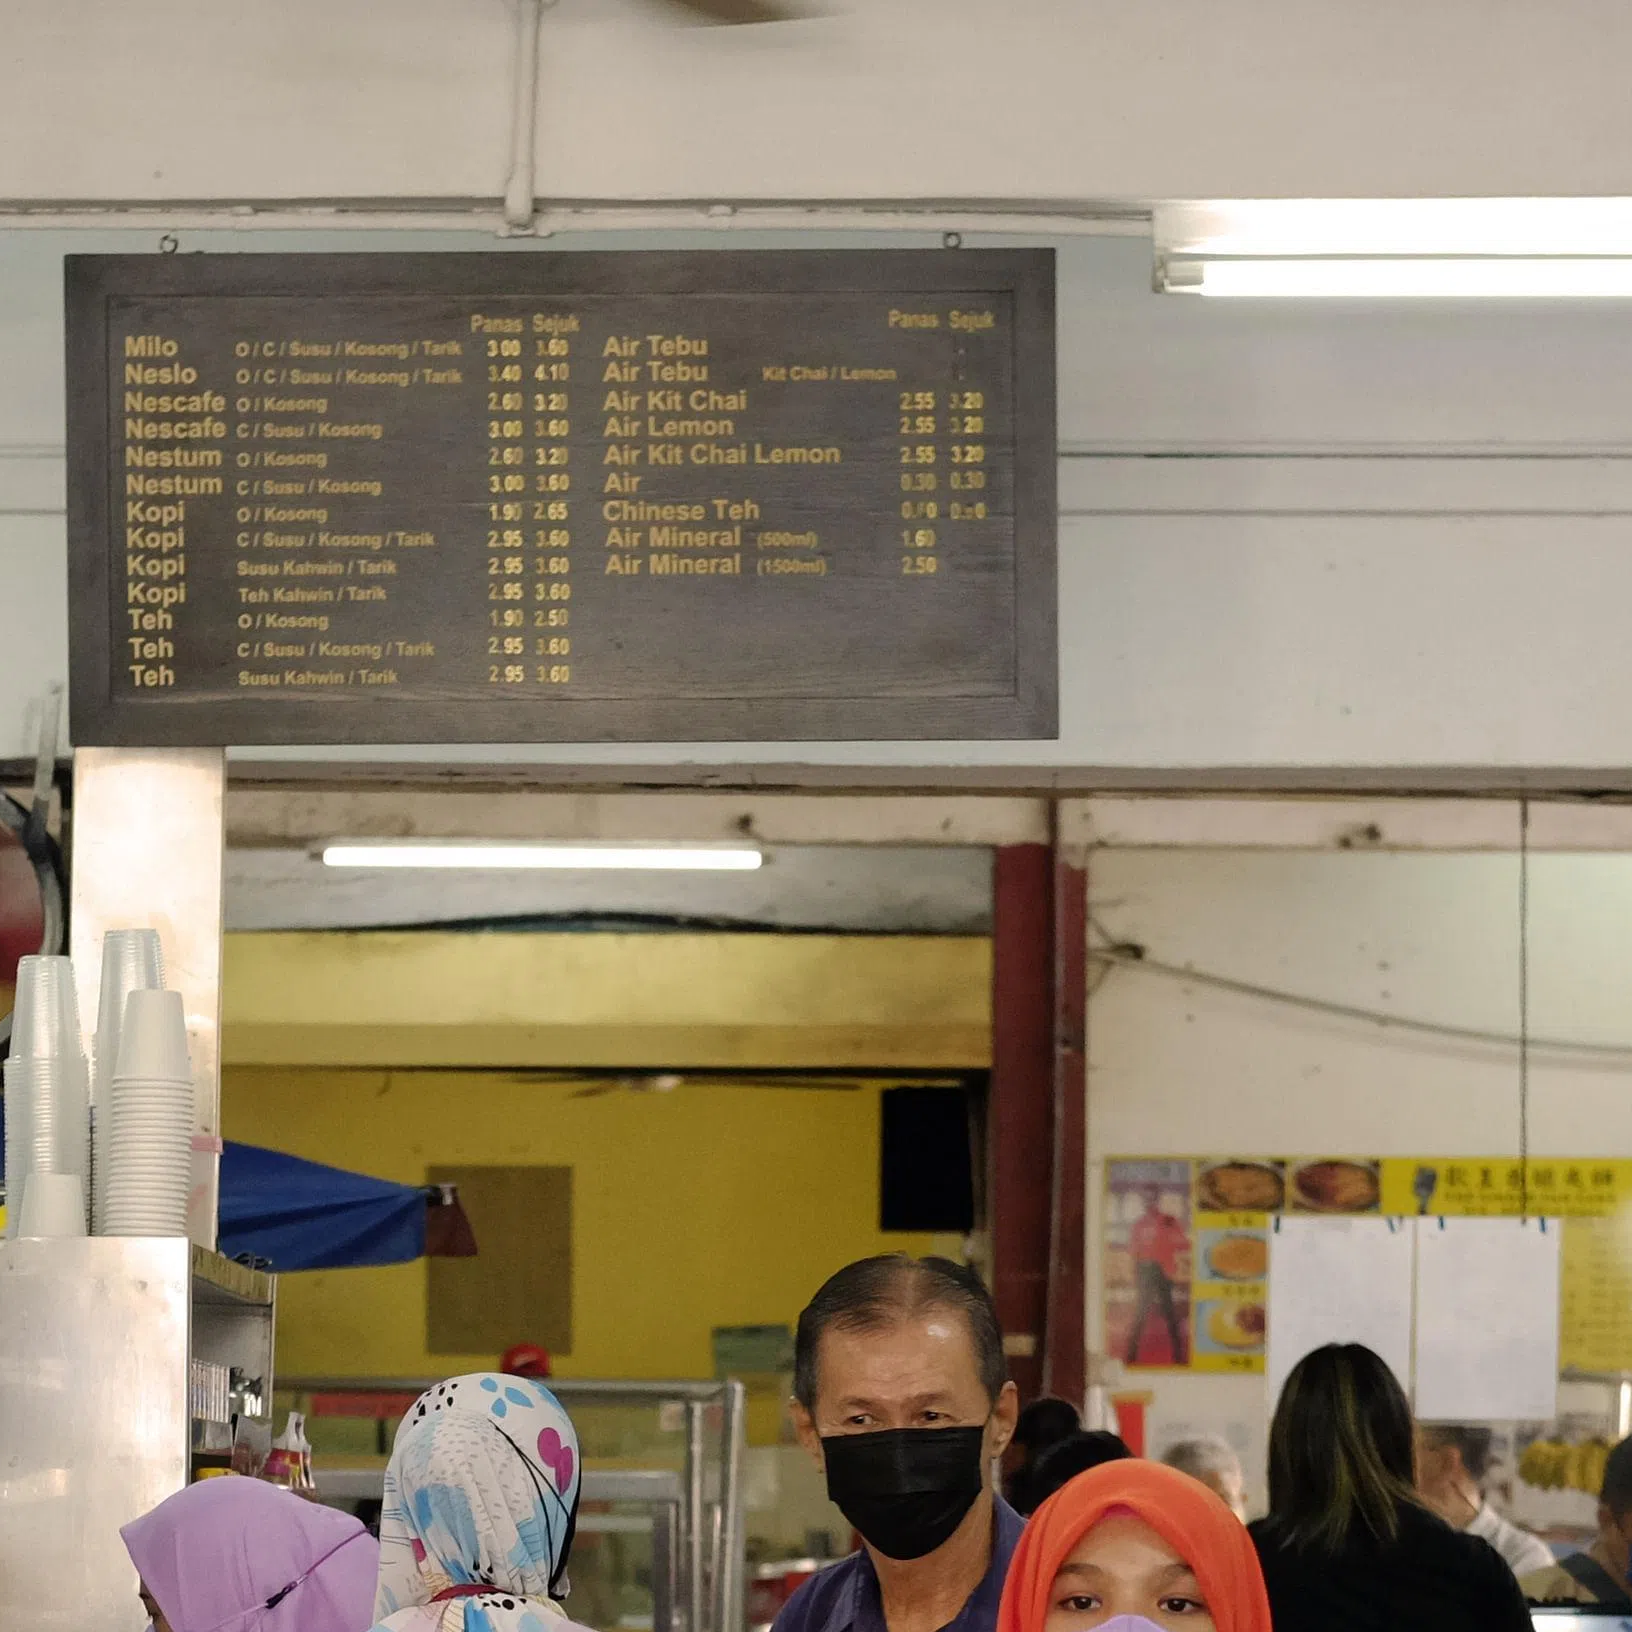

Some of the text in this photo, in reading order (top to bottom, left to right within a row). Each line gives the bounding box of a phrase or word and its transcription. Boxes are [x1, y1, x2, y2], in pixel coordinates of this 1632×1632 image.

[471, 313, 580, 336] Panas Sejuk
[889, 309, 994, 332] Panas Sejuk
[125, 336, 178, 357] Milo
[235, 342, 248, 357] O
[262, 342, 275, 356] C
[289, 341, 331, 357] Susu
[345, 341, 409, 359] Kosong
[423, 340, 462, 356] Tarik
[603, 335, 708, 356] Air Tebu
[125, 363, 196, 385] Neslo
[235, 369, 248, 384] O
[264, 369, 276, 384] C
[290, 369, 332, 384] Susu
[346, 369, 409, 386] Kosong
[423, 368, 462, 383] Tarik
[603, 361, 896, 382] Air Tebu Kit Chai Lemon
[125, 391, 225, 413] Nescafe
[236, 398, 249, 412] O
[264, 398, 327, 413] Kosong
[603, 391, 641, 411] Air
[648, 390, 682, 410] Kit
[690, 389, 747, 410] Chai
[125, 417, 226, 439] Nescafe
[236, 423, 249, 438] C
[264, 423, 304, 438] Susu
[319, 423, 382, 440] Kosong
[604, 417, 641, 437] Air
[648, 416, 734, 436] Lemon
[125, 446, 222, 468] Nestum
[237, 453, 249, 467] O
[264, 452, 327, 468] Kosong
[604, 445, 641, 465] Air
[648, 444, 684, 465] Kit
[690, 444, 746, 464] Chai
[755, 444, 841, 464] Lemon
[126, 474, 222, 495] Nestum
[237, 481, 249, 495] C
[264, 480, 304, 494] Susu
[318, 479, 382, 496] Kosong
[604, 472, 641, 492] Air
[127, 501, 184, 526] Kopi
[237, 508, 249, 522] O
[264, 507, 328, 523] Kosong
[603, 501, 705, 521] Chinese
[712, 500, 760, 520] Teh
[127, 527, 184, 553] Kopi
[237, 533, 249, 546] C
[264, 532, 304, 547] Susu
[319, 532, 382, 549] Kosong
[397, 532, 435, 546] Tarik
[606, 528, 641, 547] Air
[649, 526, 740, 547] Mineral
[127, 554, 185, 580] Kopi
[237, 561, 279, 576] Susu
[283, 560, 344, 575] Kahwin
[359, 559, 397, 574] Tarik
[606, 555, 642, 575] Air
[649, 554, 740, 574] Mineral
[128, 582, 186, 607] Kopi
[239, 588, 268, 602] Teh
[273, 587, 334, 602] Kahwin
[348, 585, 386, 600] Tarik
[128, 609, 172, 630] Teh
[238, 614, 251, 628] O
[266, 613, 329, 630] Kosong
[128, 637, 173, 659] Teh
[237, 643, 249, 657] C
[264, 642, 305, 657] Susu
[319, 642, 381, 659] Kosong
[396, 641, 435, 656] Tarik
[129, 665, 174, 687] Teh
[238, 671, 280, 685] Susu
[284, 670, 344, 684] Kahwin
[359, 669, 398, 684] Tarik
